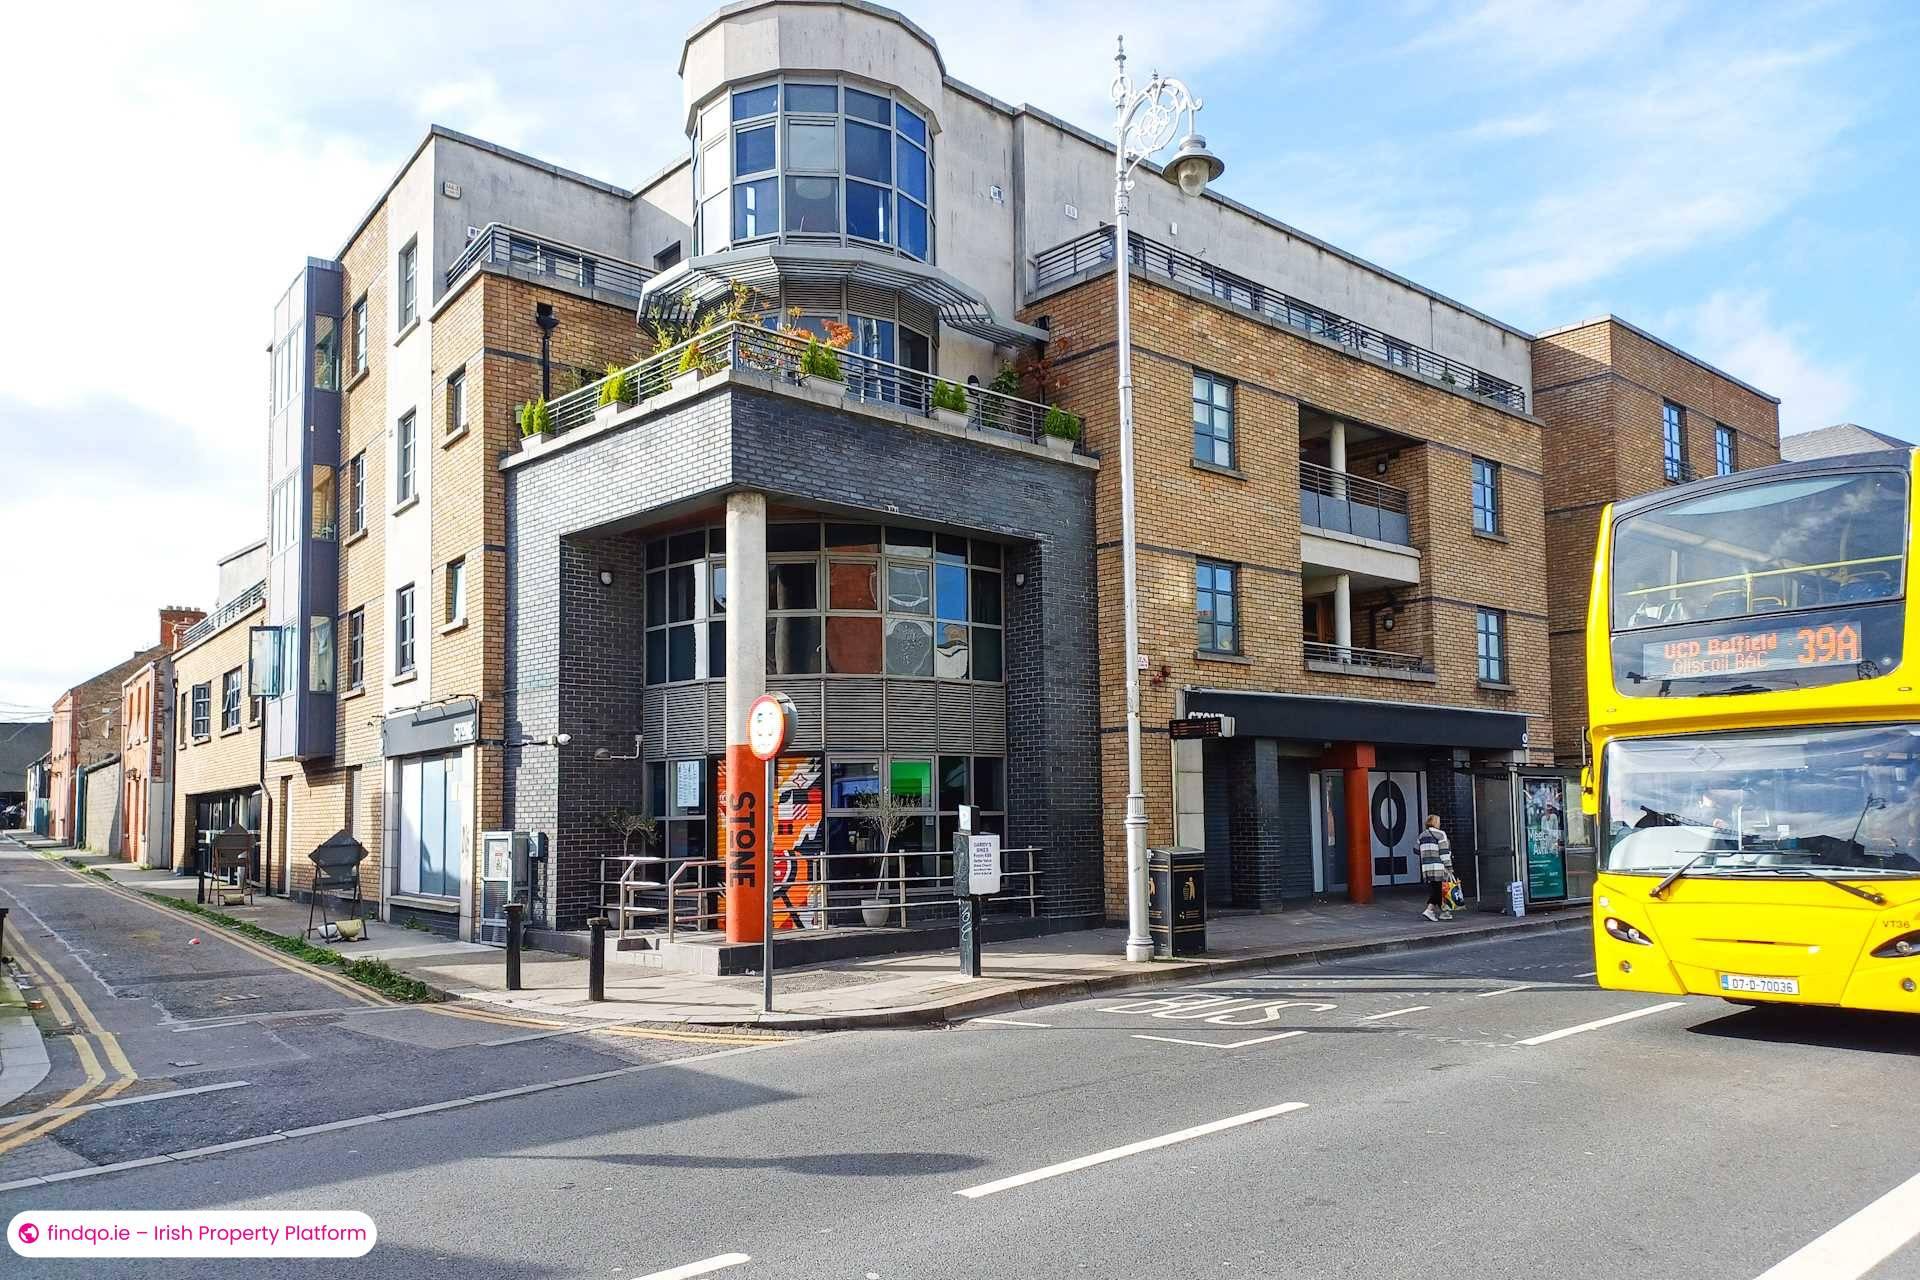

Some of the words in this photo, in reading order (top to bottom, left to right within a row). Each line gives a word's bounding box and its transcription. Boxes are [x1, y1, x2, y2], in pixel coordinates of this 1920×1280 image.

[1664, 640, 1700, 659] UCD
[1708, 632, 1777, 655] Belfield
[1796, 624, 1859, 664] 39A
[729, 791, 756, 888] STONE
[1882, 920, 1910, 928] VT36
[1732, 978, 1793, 993] 07-D-70036
[1096, 993, 1338, 1025] BUS
